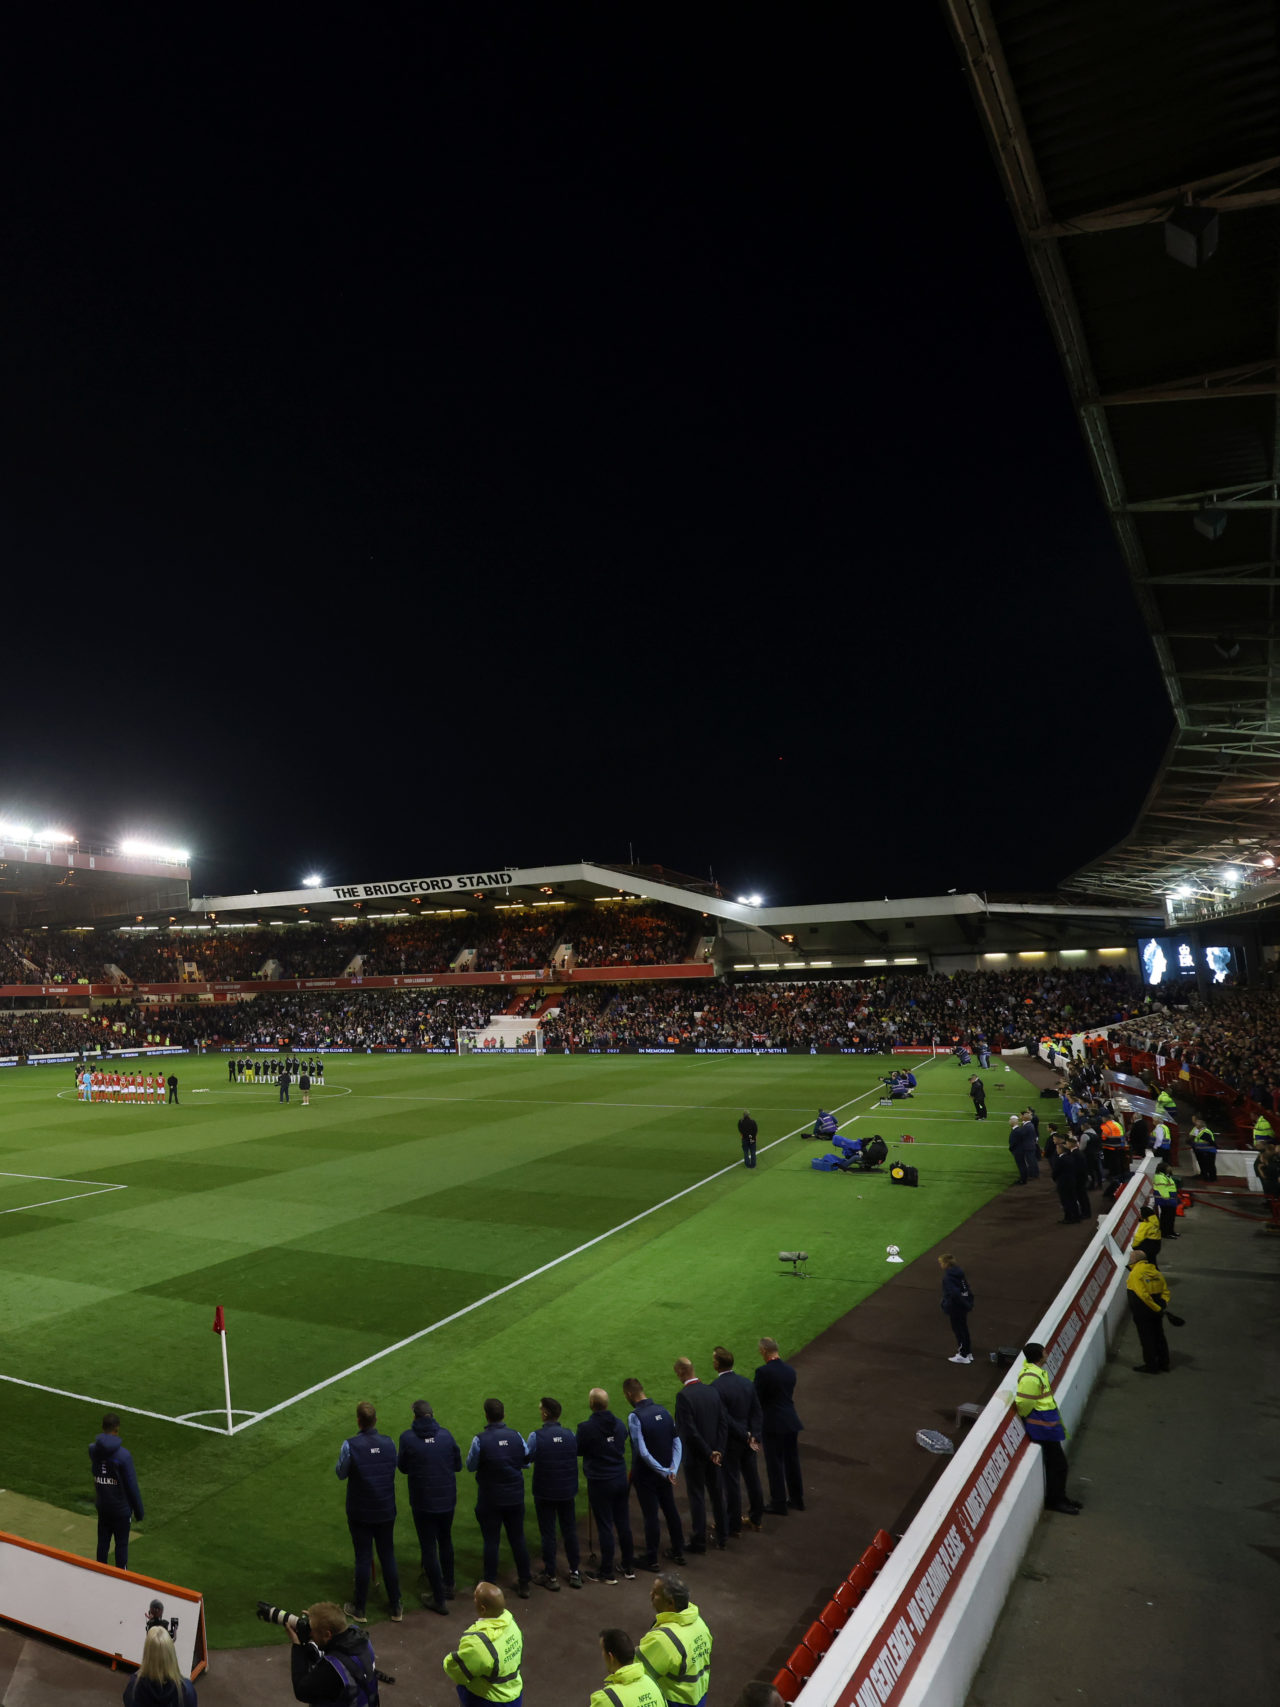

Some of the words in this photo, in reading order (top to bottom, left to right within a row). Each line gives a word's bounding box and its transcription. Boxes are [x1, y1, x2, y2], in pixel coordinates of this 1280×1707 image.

[333, 887, 360, 899] THE
[364, 878, 453, 896] BRIDGFORD
[456, 873, 513, 889] STAND
[868, 1615, 917, 1704] GENTLEMEN
[914, 1552, 952, 1621] SWEARING
[938, 1523, 966, 1572] PLEASE
